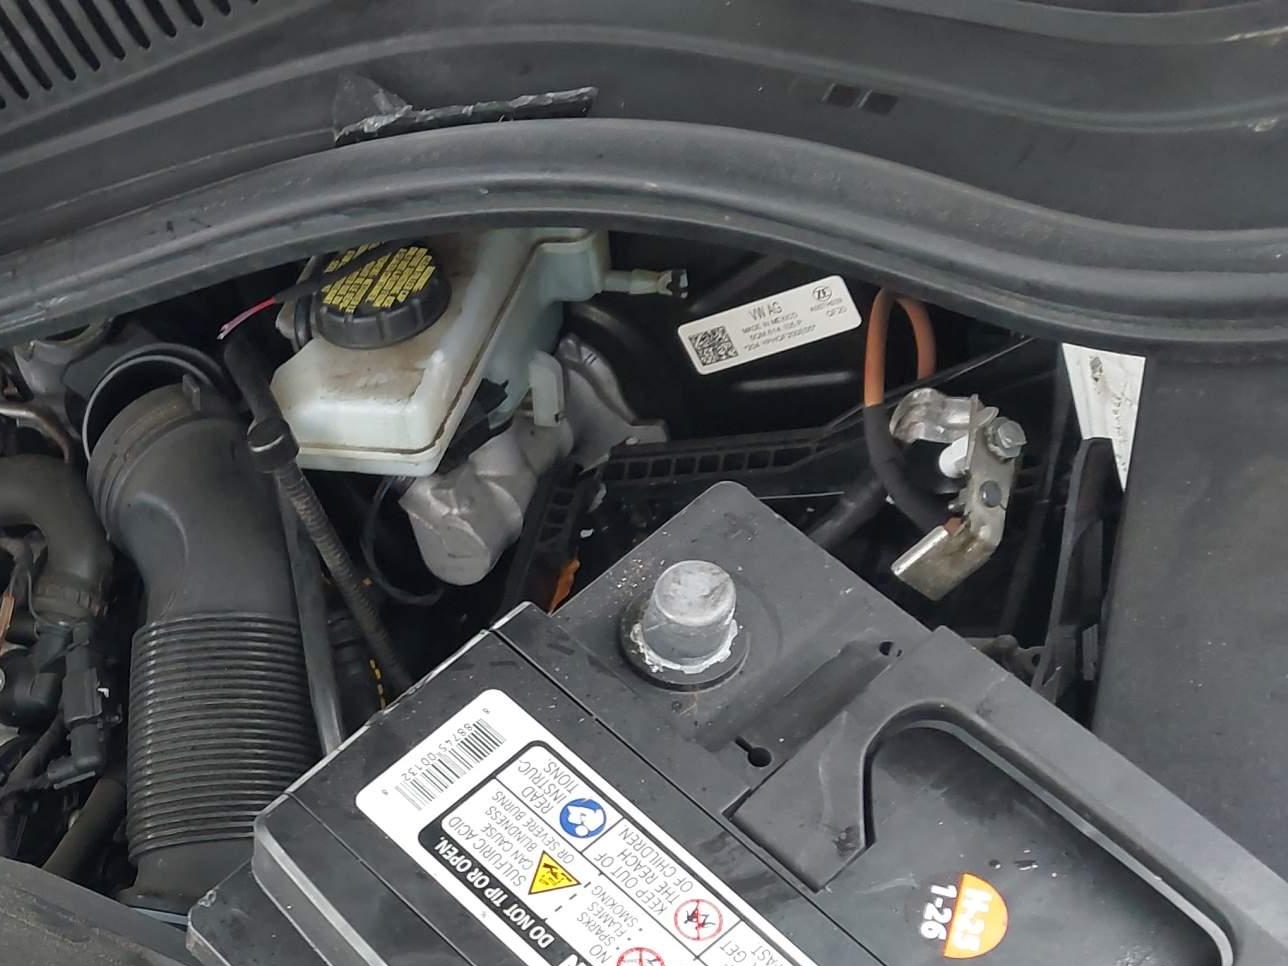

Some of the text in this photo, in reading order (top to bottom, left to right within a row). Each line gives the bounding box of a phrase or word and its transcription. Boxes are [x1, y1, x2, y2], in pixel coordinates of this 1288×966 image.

[520, 785, 554, 815] READ
[480, 822, 534, 871] CAN CAUSE
[484, 805, 538, 853] BLINDNESS
[521, 817, 561, 852] SEVERE
[448, 816, 527, 887] SULFURIC ACID
[556, 848, 575, 865] OR
[434, 836, 555, 949] DO NOT TIP OR OPEN.
[593, 852, 668, 916] KEEP OUT OF
[616, 848, 681, 905] THE REACH
[672, 877, 694, 893] OF
[586, 901, 627, 938] FLAMES
[591, 885, 639, 928] SMOKING
[920, 884, 958, 940] 1-26
[576, 911, 616, 947] SPARKS
[588, 943, 612, 965] NO
[719, 940, 748, 963] GET
